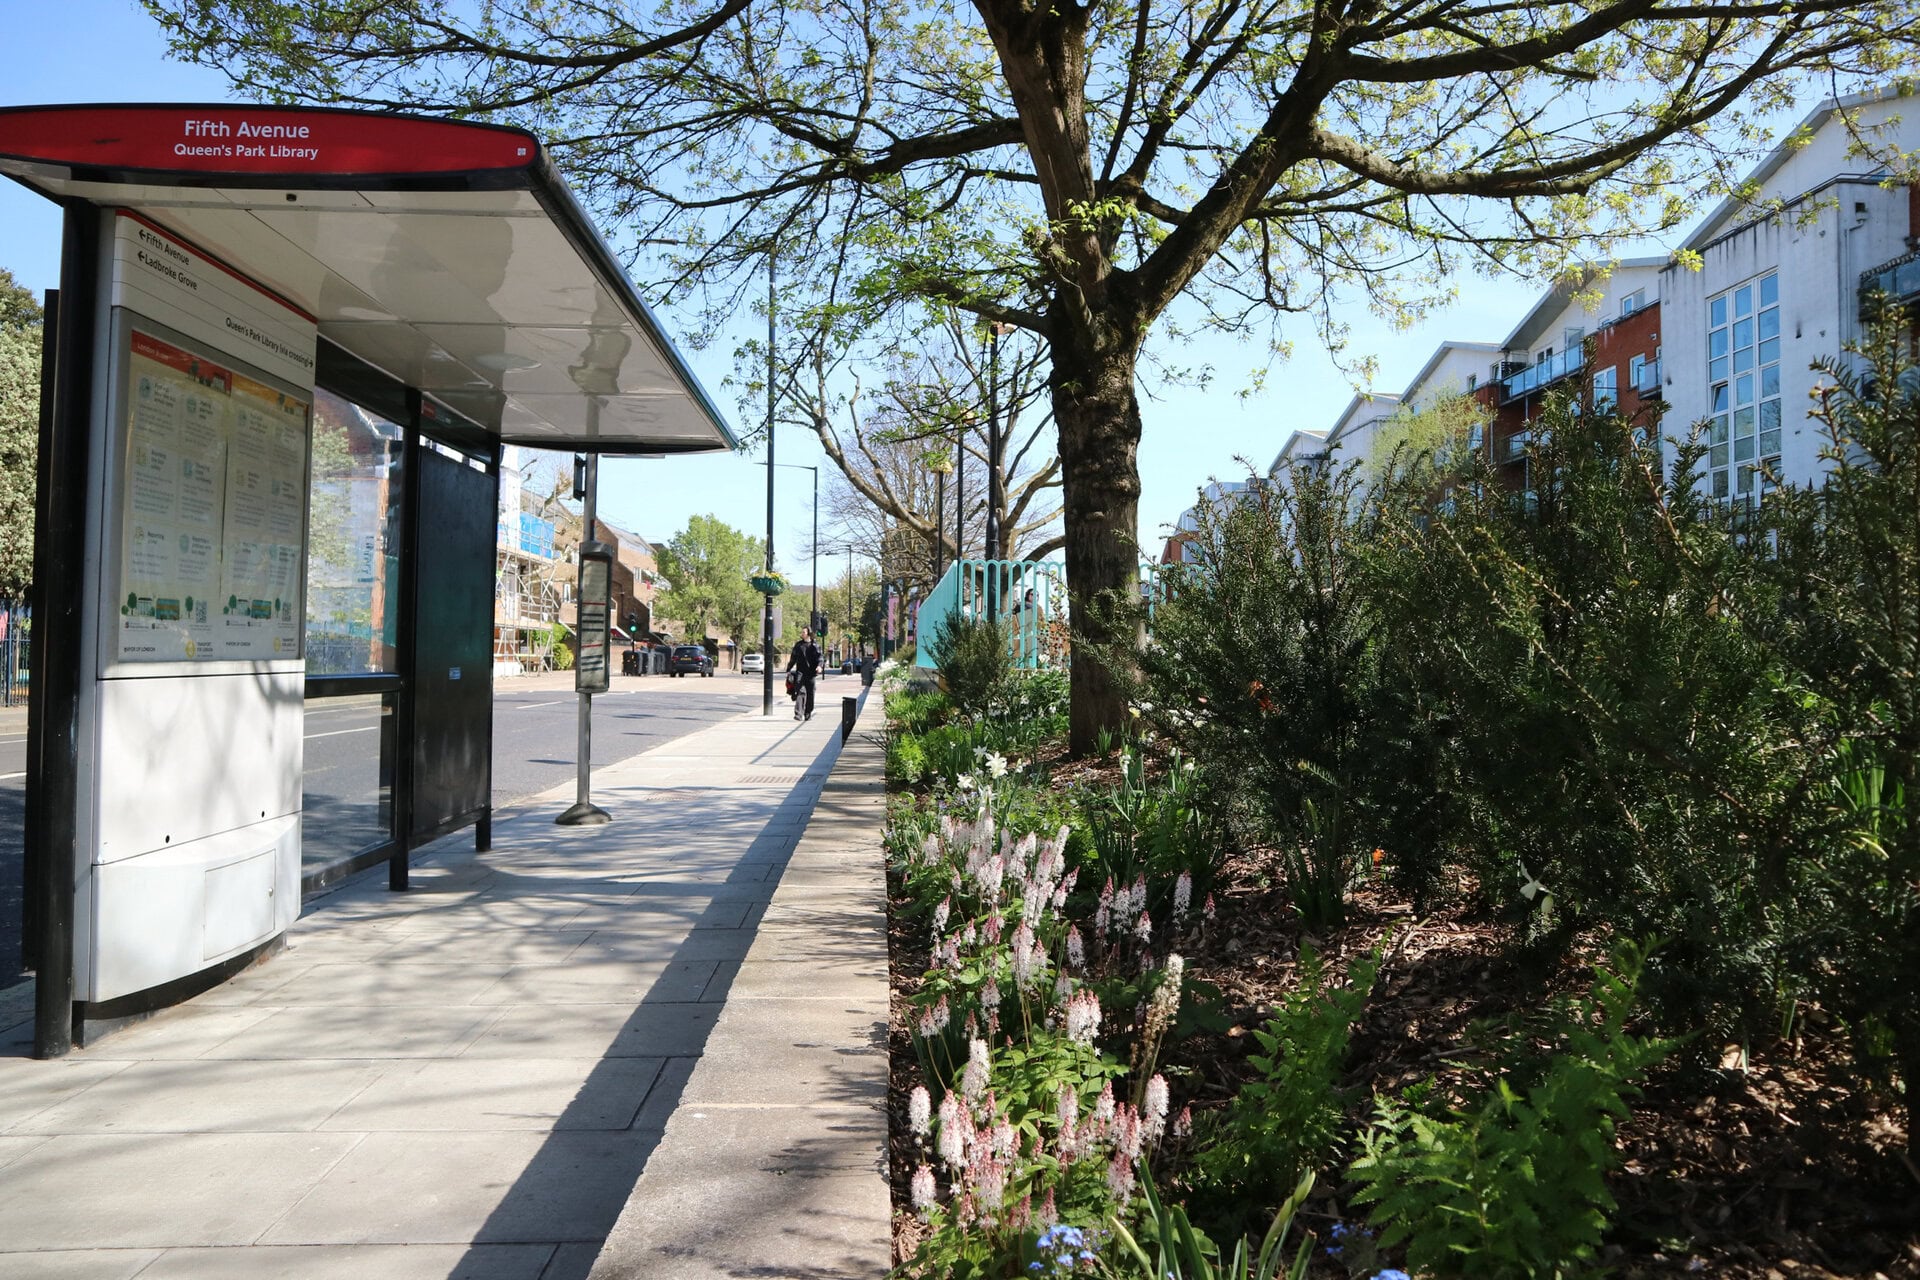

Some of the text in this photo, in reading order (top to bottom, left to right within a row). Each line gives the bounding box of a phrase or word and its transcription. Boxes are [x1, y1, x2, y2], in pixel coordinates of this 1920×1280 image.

[184, 120, 310, 139] Fifth Avenue
[174, 143, 319, 160] Queen's Park Library
[146, 232, 190, 266] Fifth Avenue
[145, 253, 198, 291] Ladbroke Grove
[225, 317, 249, 337] Queen's
[249, 328, 261, 342] Park
[261, 335, 279, 353] Library
